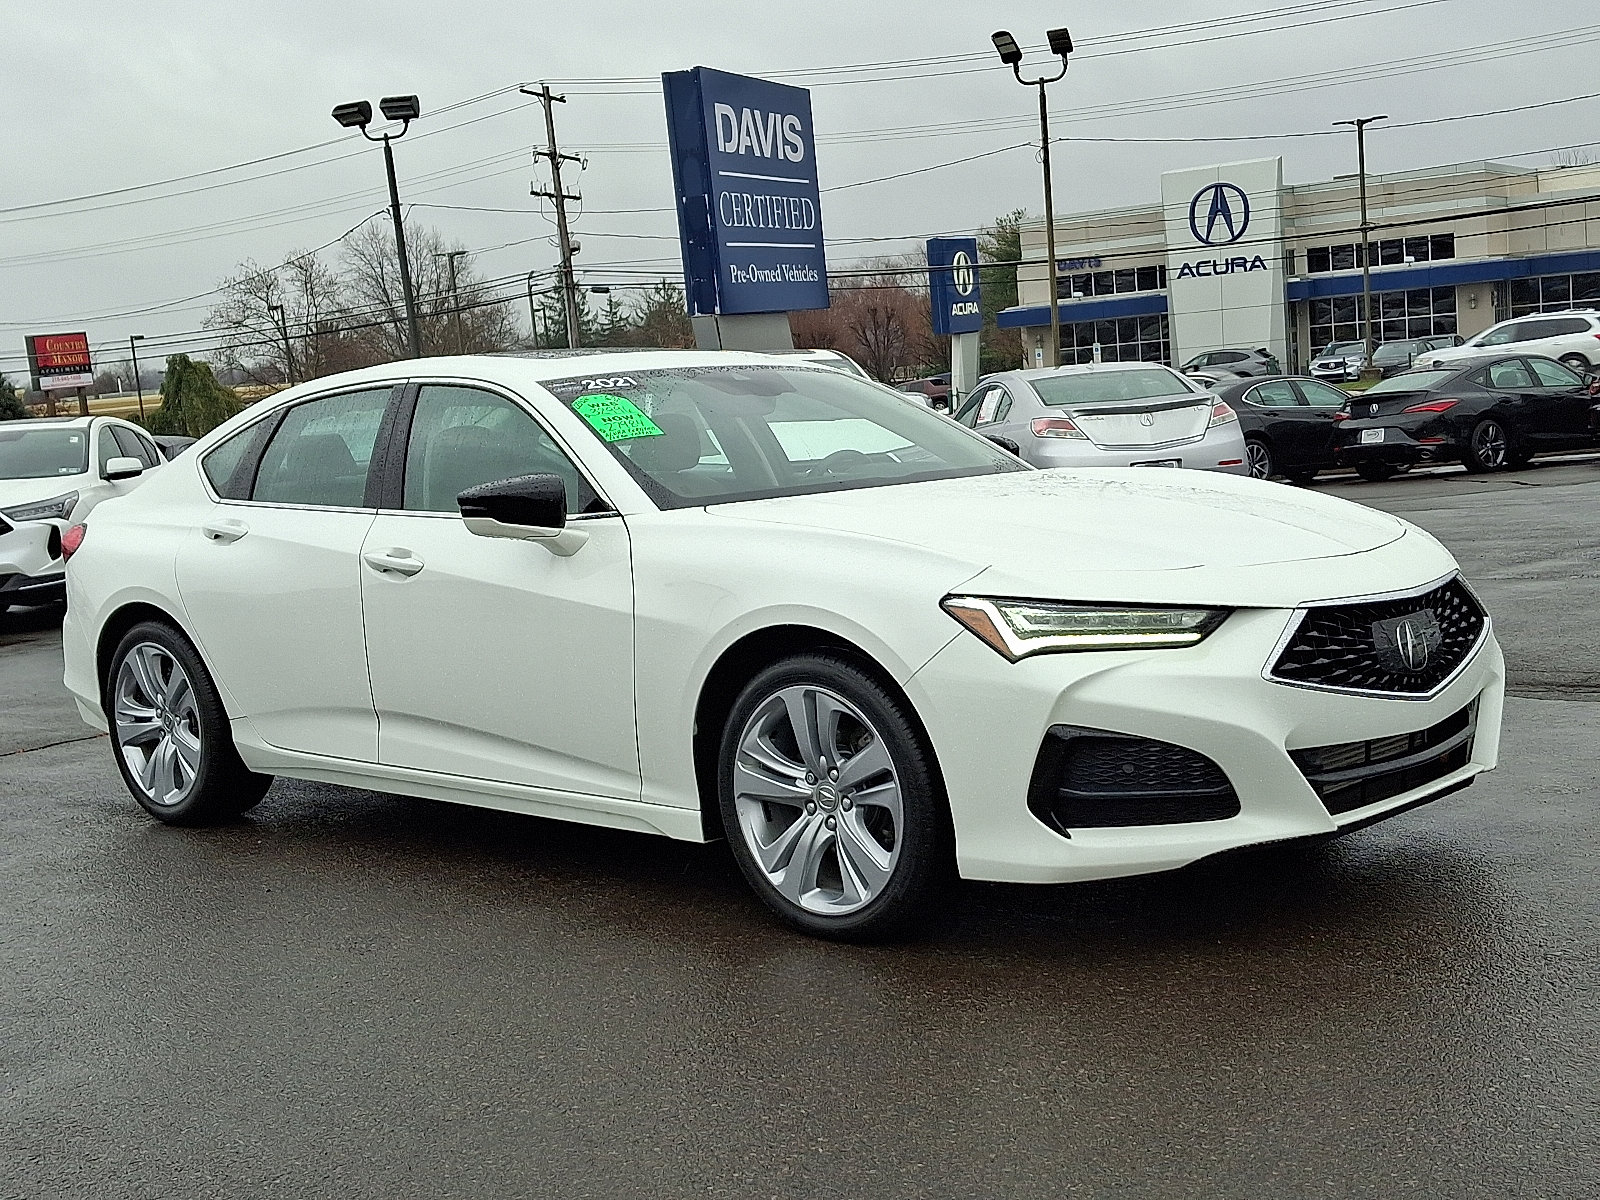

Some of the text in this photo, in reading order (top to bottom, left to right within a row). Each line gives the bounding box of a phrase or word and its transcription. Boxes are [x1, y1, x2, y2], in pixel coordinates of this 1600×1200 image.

[714, 103, 804, 163] DAVIS
[720, 191, 815, 230] CERTIFIED
[730, 264, 818, 284] Pre-Owned Vehicles
[1176, 255, 1268, 280] ACURA
[952, 302, 979, 316] ACURA
[581, 376, 638, 389] 2021
